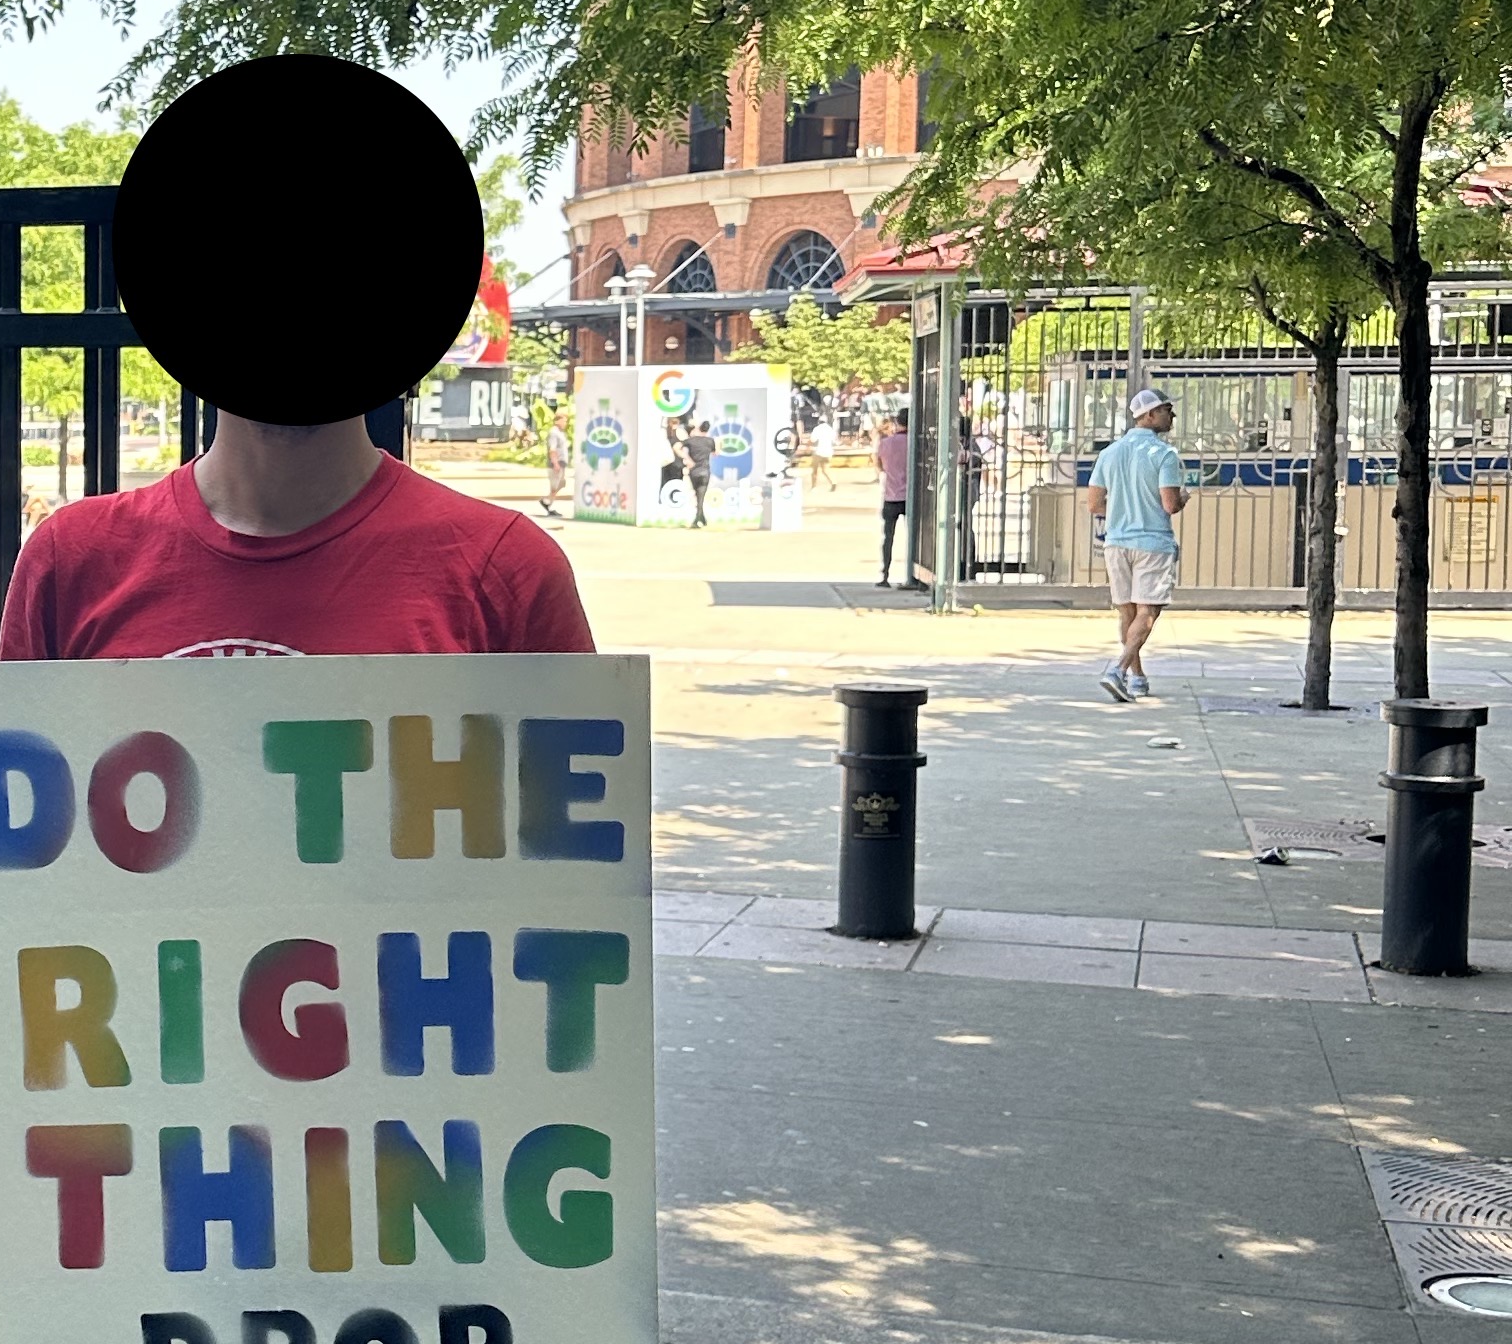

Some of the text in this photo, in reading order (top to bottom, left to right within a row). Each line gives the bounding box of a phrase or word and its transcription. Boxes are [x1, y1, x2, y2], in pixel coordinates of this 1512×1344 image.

[581, 480, 628, 516] Google
[261, 714, 625, 864] THE
[17, 927, 630, 1092] RIGHT
[25, 1119, 615, 1273] THING
